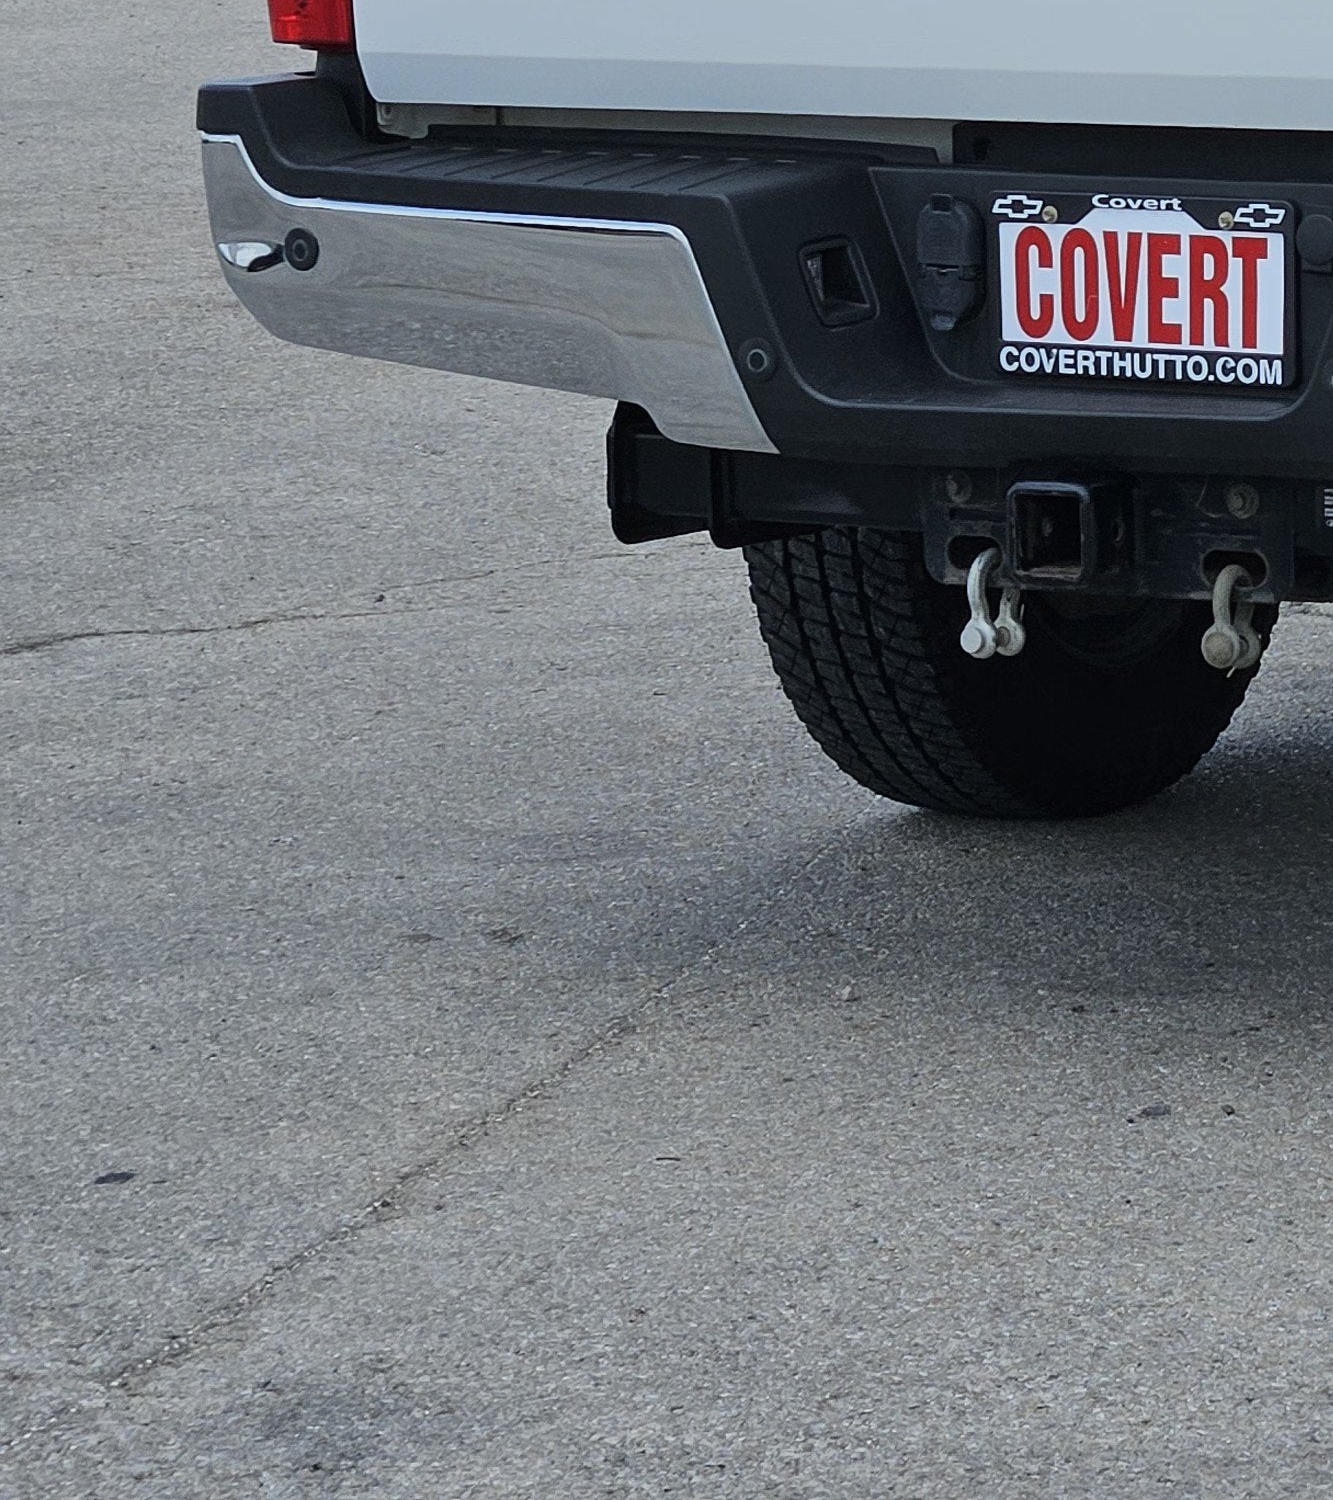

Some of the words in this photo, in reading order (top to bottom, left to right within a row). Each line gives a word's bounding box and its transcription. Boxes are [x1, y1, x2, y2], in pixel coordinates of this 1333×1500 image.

[1091, 193, 1183, 211] Covert
[1015, 225, 1268, 349] COVERT
[1000, 346, 1283, 385] COVERTHUTTO.COM
